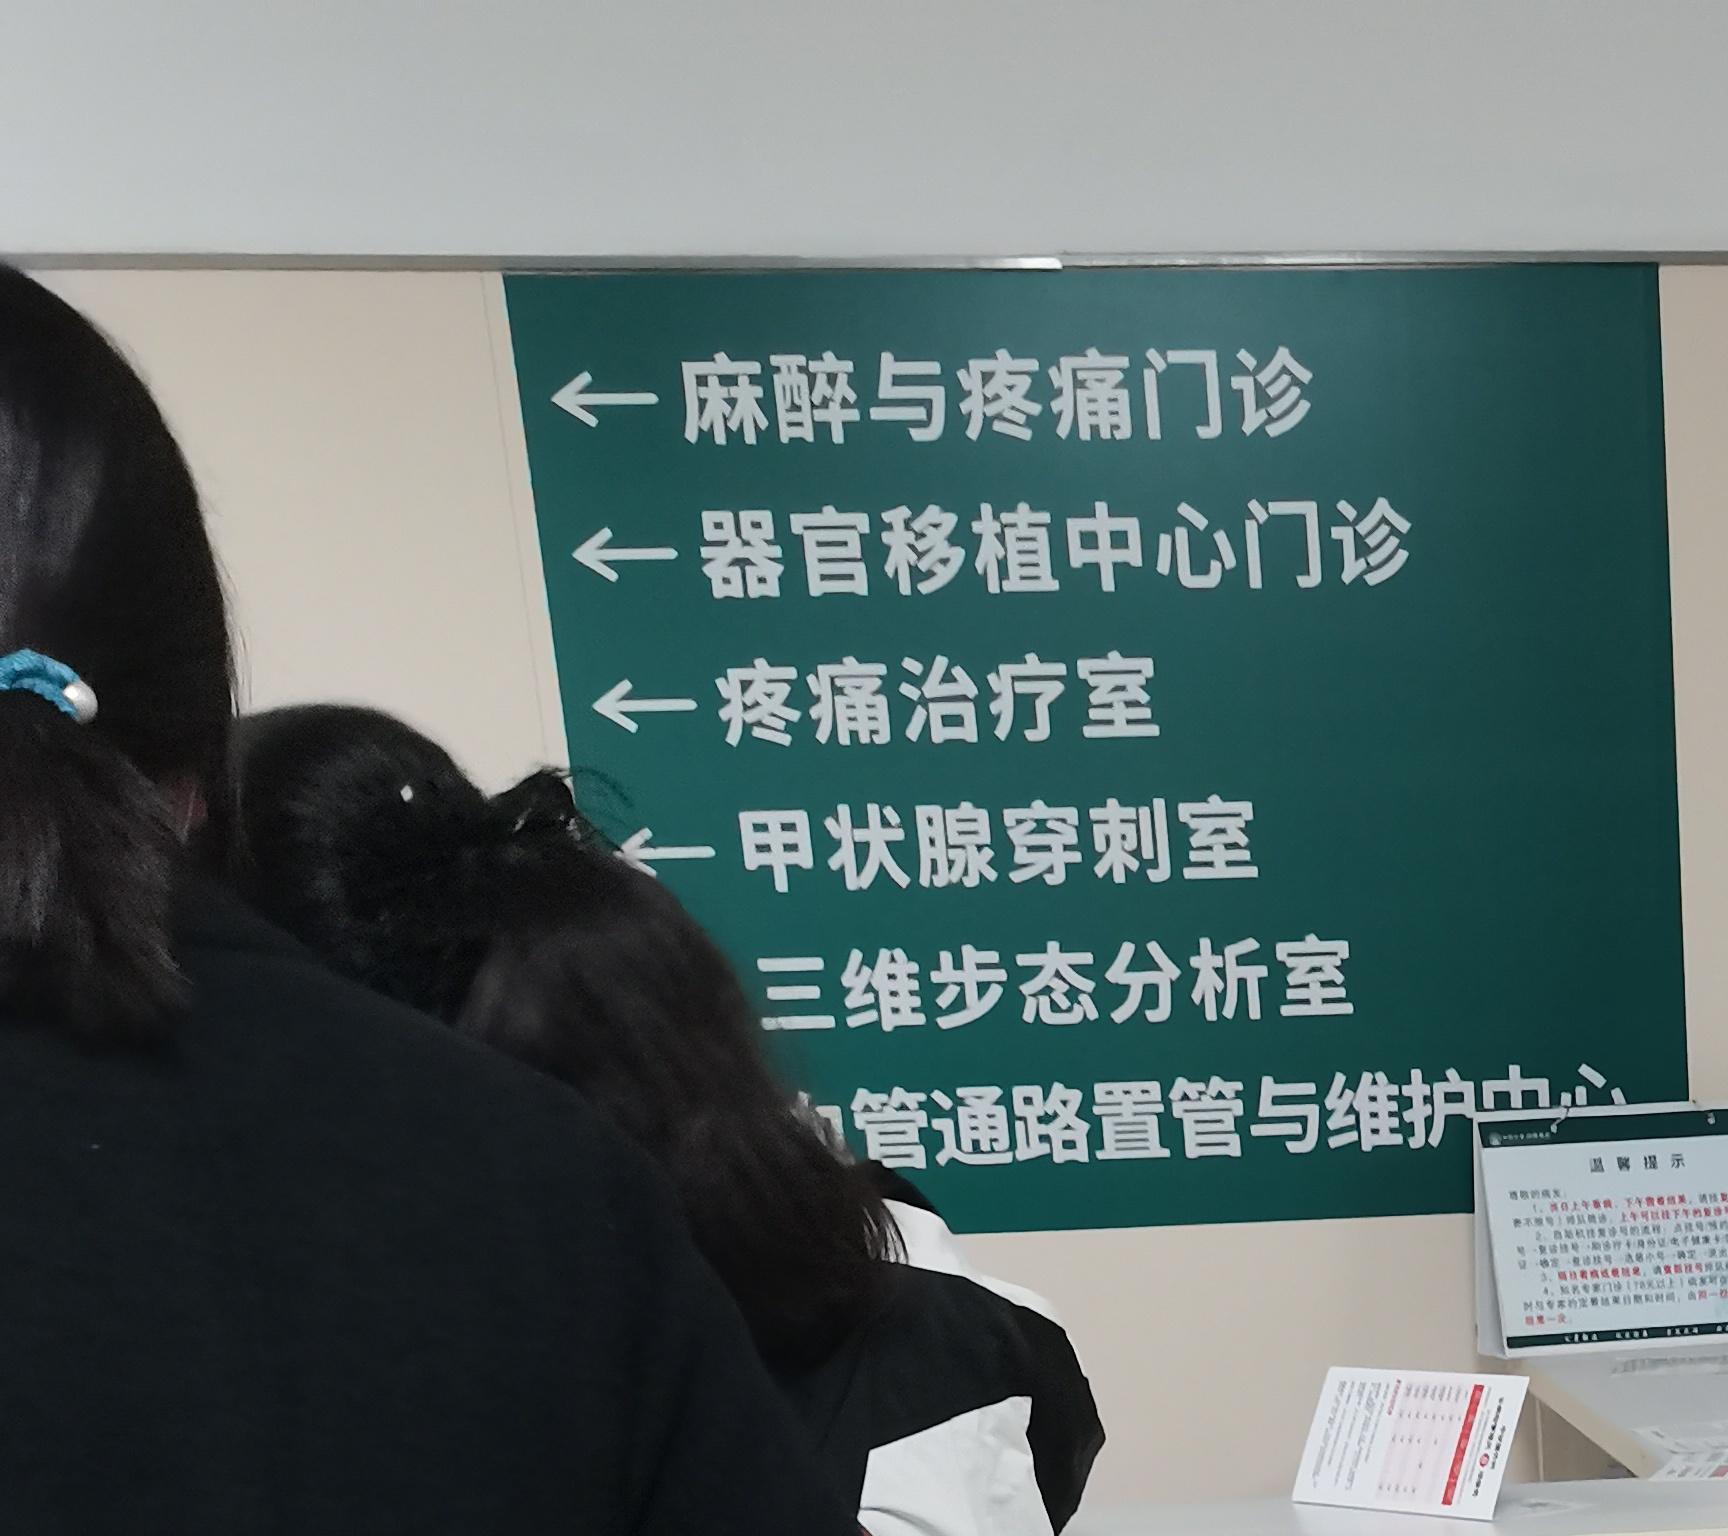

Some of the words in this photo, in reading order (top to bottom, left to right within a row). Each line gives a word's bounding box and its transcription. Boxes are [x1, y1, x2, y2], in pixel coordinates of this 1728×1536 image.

[681, 346, 1314, 446] 麻醉与疼痛门诊
[699, 497, 1413, 600] 器官移植中心门诊
[714, 650, 1161, 748] 疼痛治疗室
[738, 794, 1260, 893] 甲状腺穿刺室
[756, 932, 1355, 1032] 三维步态分析室
[806, 1063, 1627, 1170] 管通路置管与维护中心
[1589, 1152, 1686, 1174] 温馨提示
